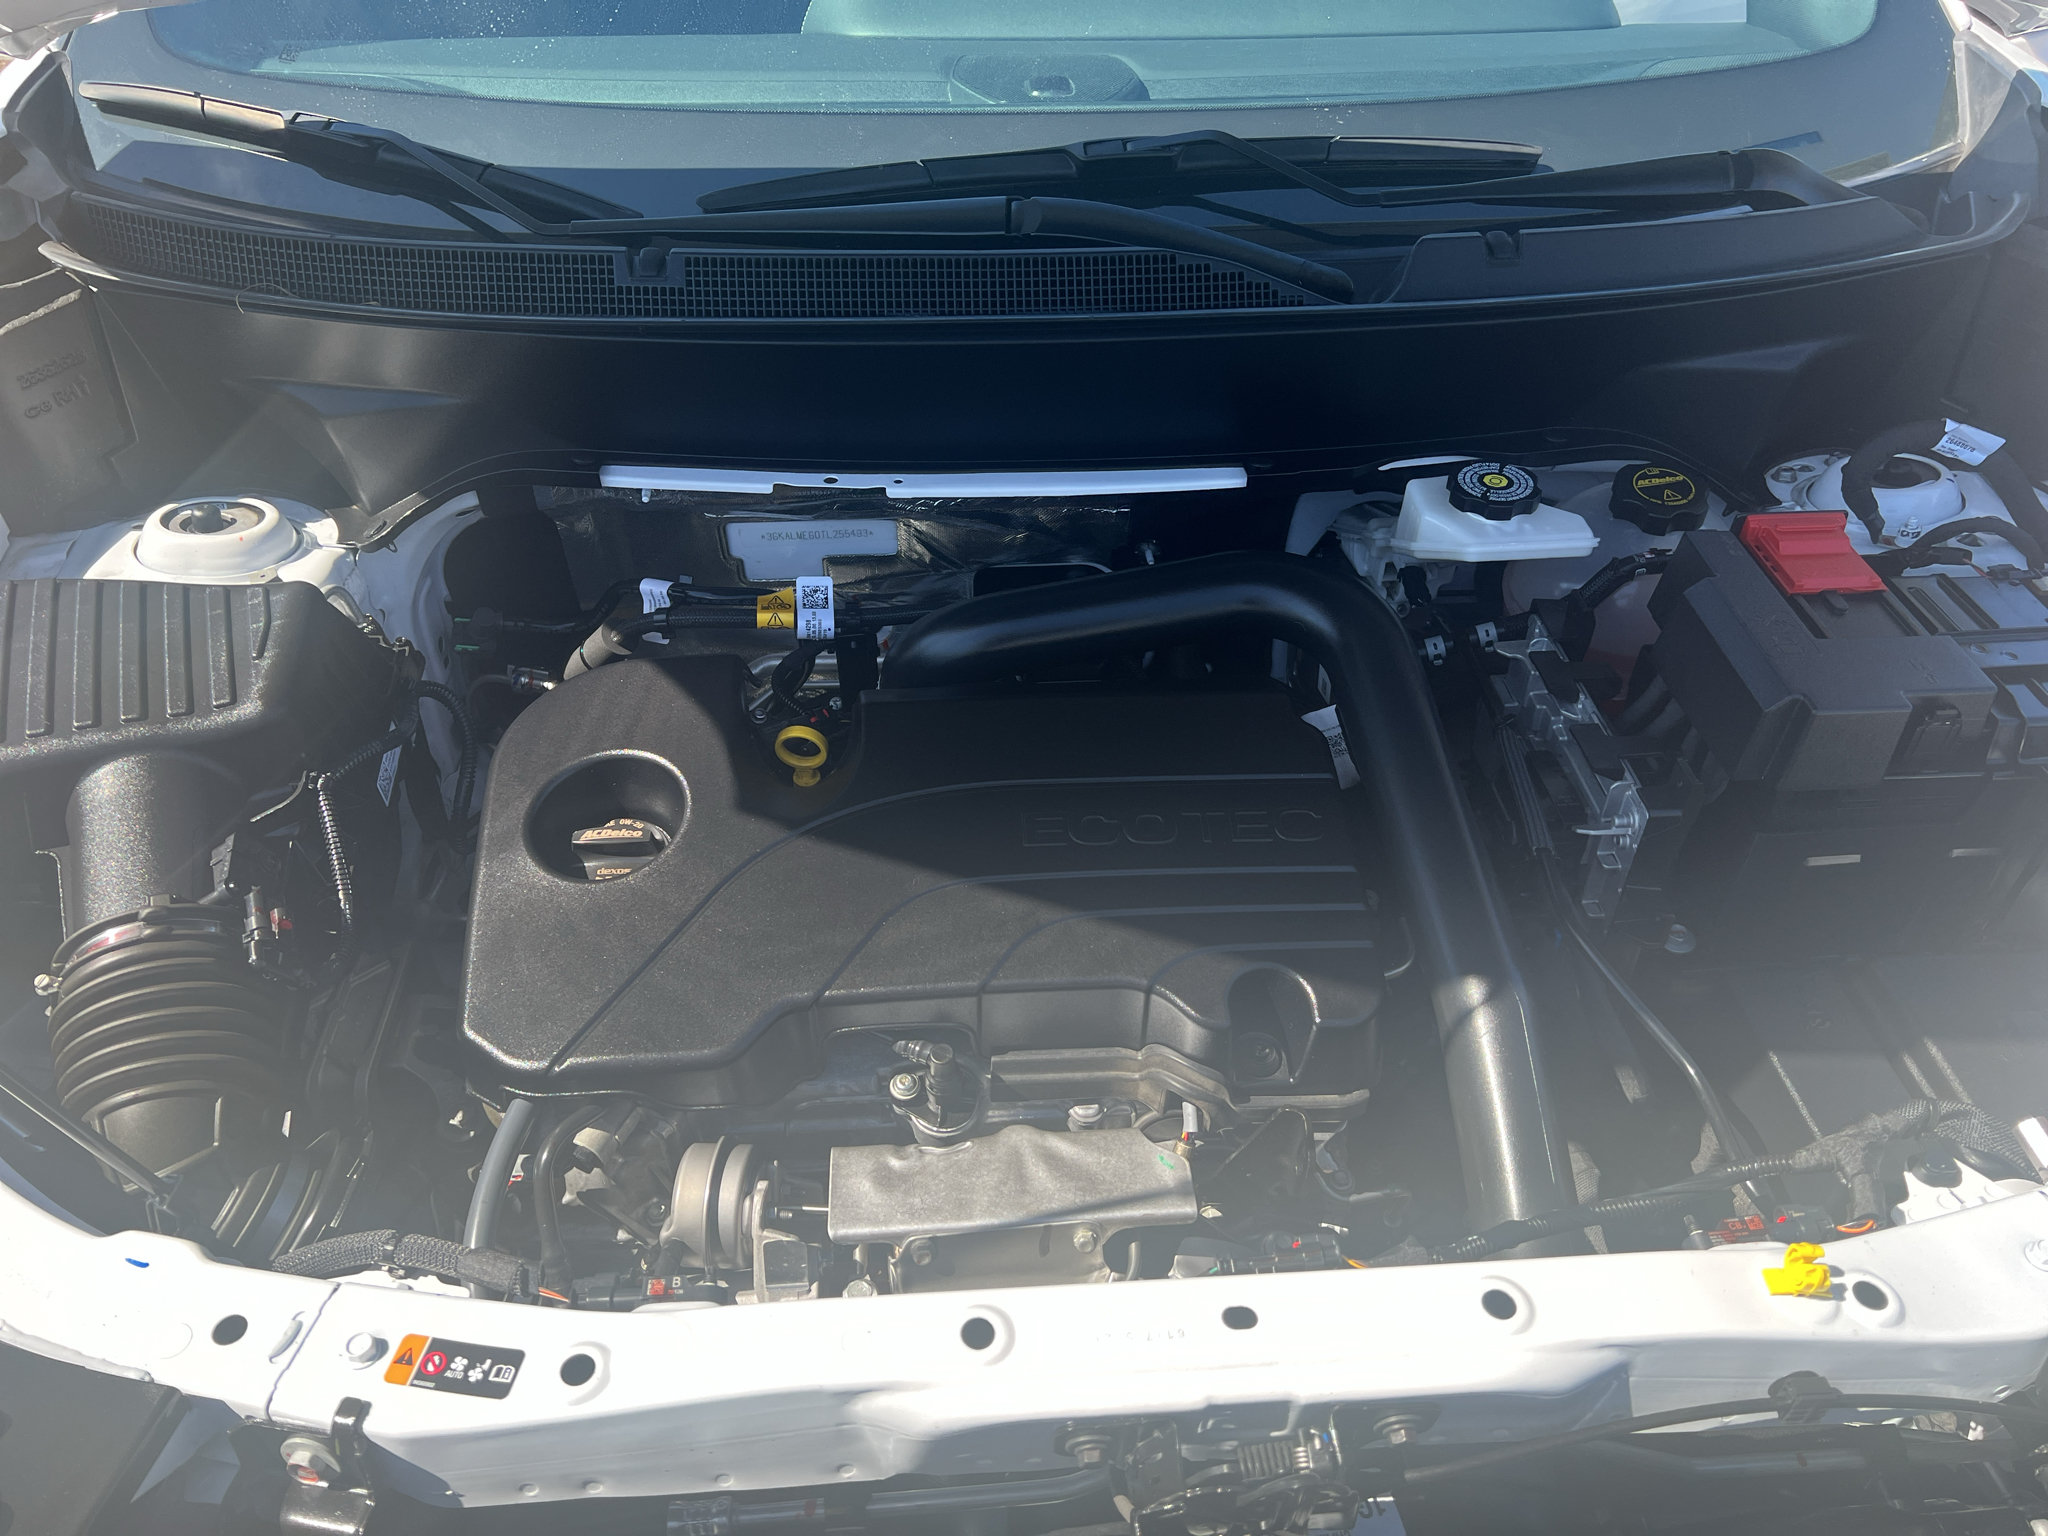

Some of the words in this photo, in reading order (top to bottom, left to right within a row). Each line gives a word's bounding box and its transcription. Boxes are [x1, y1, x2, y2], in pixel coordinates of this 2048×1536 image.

[1637, 475, 1684, 487] ACDelco
[1022, 809, 1325, 847] ECOTEC
[580, 828, 644, 841] ACDelco
[444, 1370, 465, 1379] AUTO
